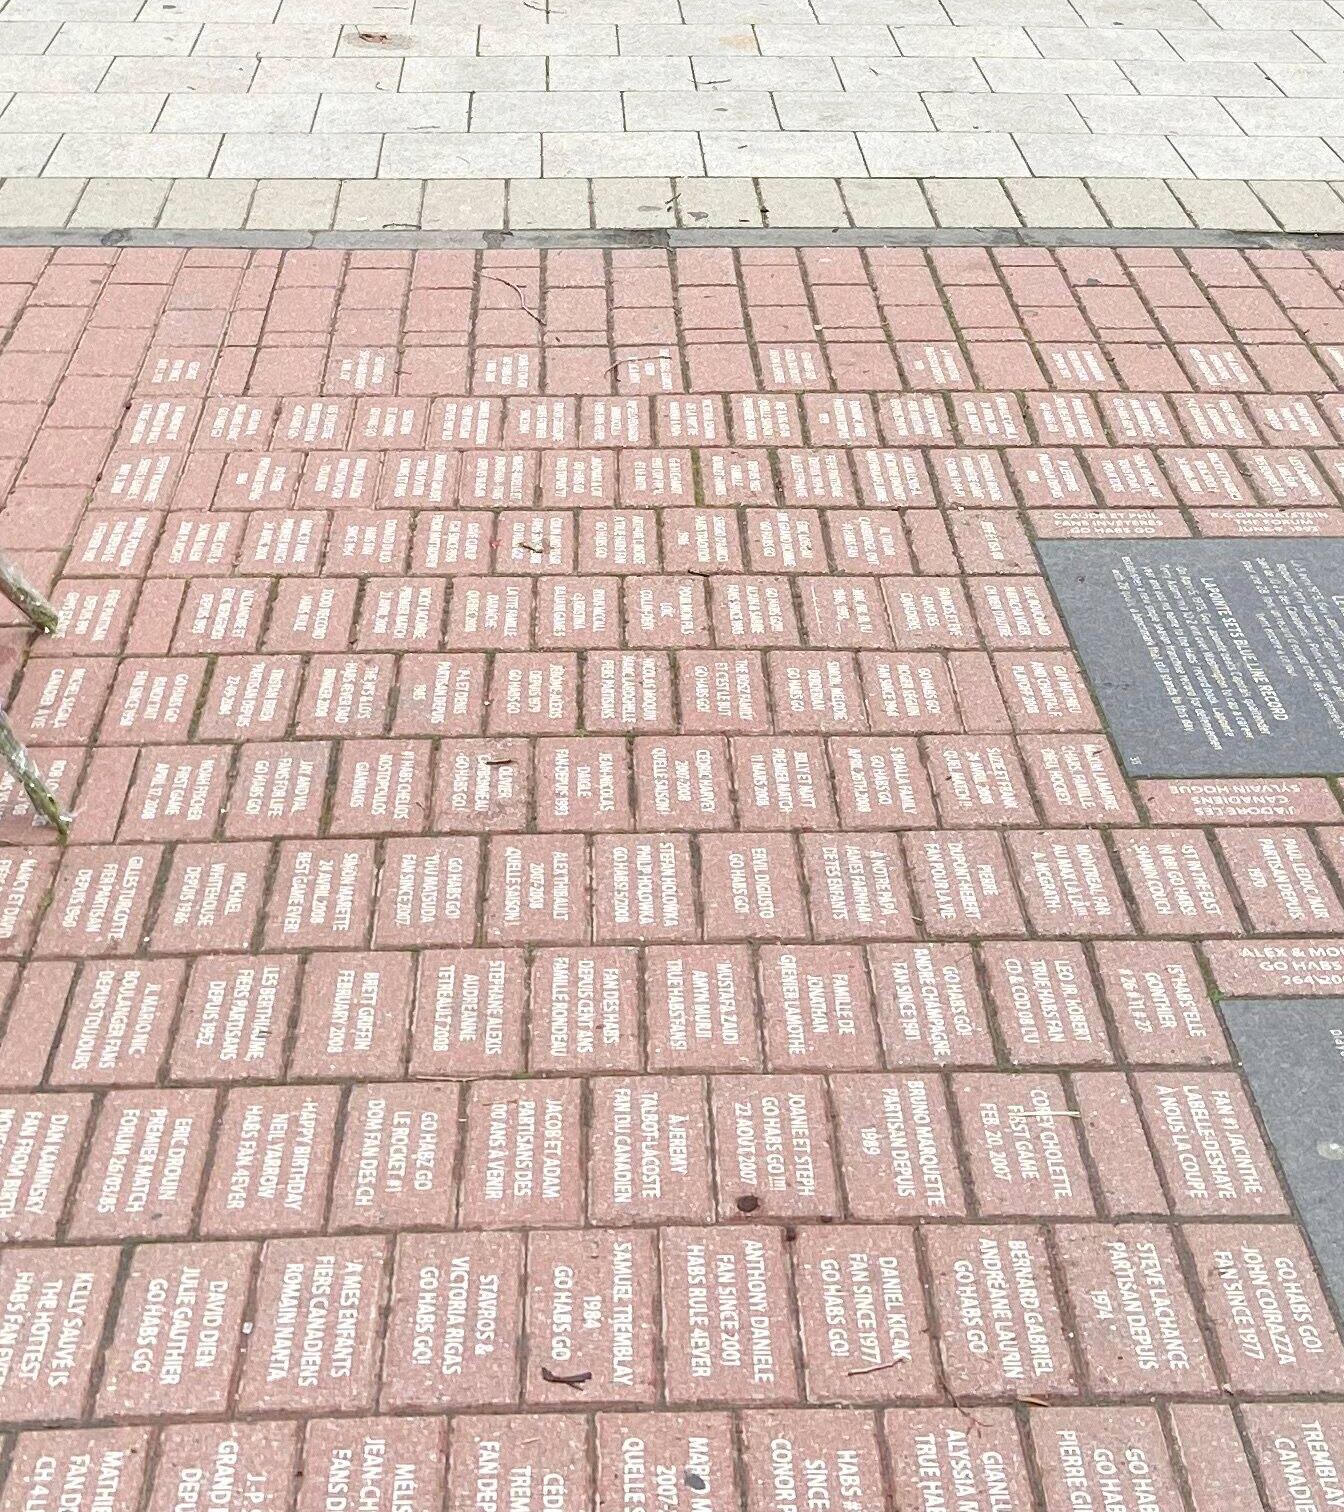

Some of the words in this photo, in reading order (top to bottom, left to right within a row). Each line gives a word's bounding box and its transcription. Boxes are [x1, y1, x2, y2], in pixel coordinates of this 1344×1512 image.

[1200, 578, 1233, 615] LAPOINTE
[1221, 618, 1244, 636] SETS
[1233, 639, 1257, 660] BLUE
[1245, 663, 1268, 682] LINE
[1257, 685, 1288, 719] RECORD
[1242, 947, 1287, 958] ALEX
[1292, 947, 1304, 957] &
[1259, 961, 1288, 971] GO
[1292, 960, 1343, 971] HABS
[952, 1260, 974, 1282] GO
[1135, 1243, 1164, 1284] STEVE
[1212, 1251, 1238, 1278] FAN
[1240, 1246, 1270, 1285] JOHN
[1273, 1257, 1297, 1279] GO
[5, 1272, 33, 1311] HABS
[36, 1280, 61, 1308] THE
[65, 1273, 93, 1314] KELLY
[145, 1278, 167, 1301] GO
[175, 1266, 199, 1304] JULIE
[202, 1280, 227, 1326] DAVID
[1090, 1289, 1114, 1318] 1974
[1222, 1282, 1254, 1324] SINCE
[1282, 1282, 1313, 1321] HABS
[137, 1304, 163, 1344] HABS
[957, 1286, 983, 1325] HABS
[1006, 1240, 1039, 1308] BERNARD
[1023, 1312, 1055, 1374] GABRIEL
[1106, 1242, 1143, 1311] PARTISAN
[1126, 1315, 1159, 1368] DEPUIS
[18, 1311, 54, 1380] HOTTEST
[160, 1307, 192, 1383] GAUTHIER
[195, 1330, 219, 1366] DIEN
[966, 1329, 988, 1353] GO
[1148, 1288, 1190, 1369] LACHANCE
[1238, 1328, 1266, 1358] 1977
[1297, 1325, 1324, 1352] GO!
[132, 1348, 155, 1372] GO
[995, 1321, 1024, 1377] LAURIN
[48, 1371, 70, 1386] IS
